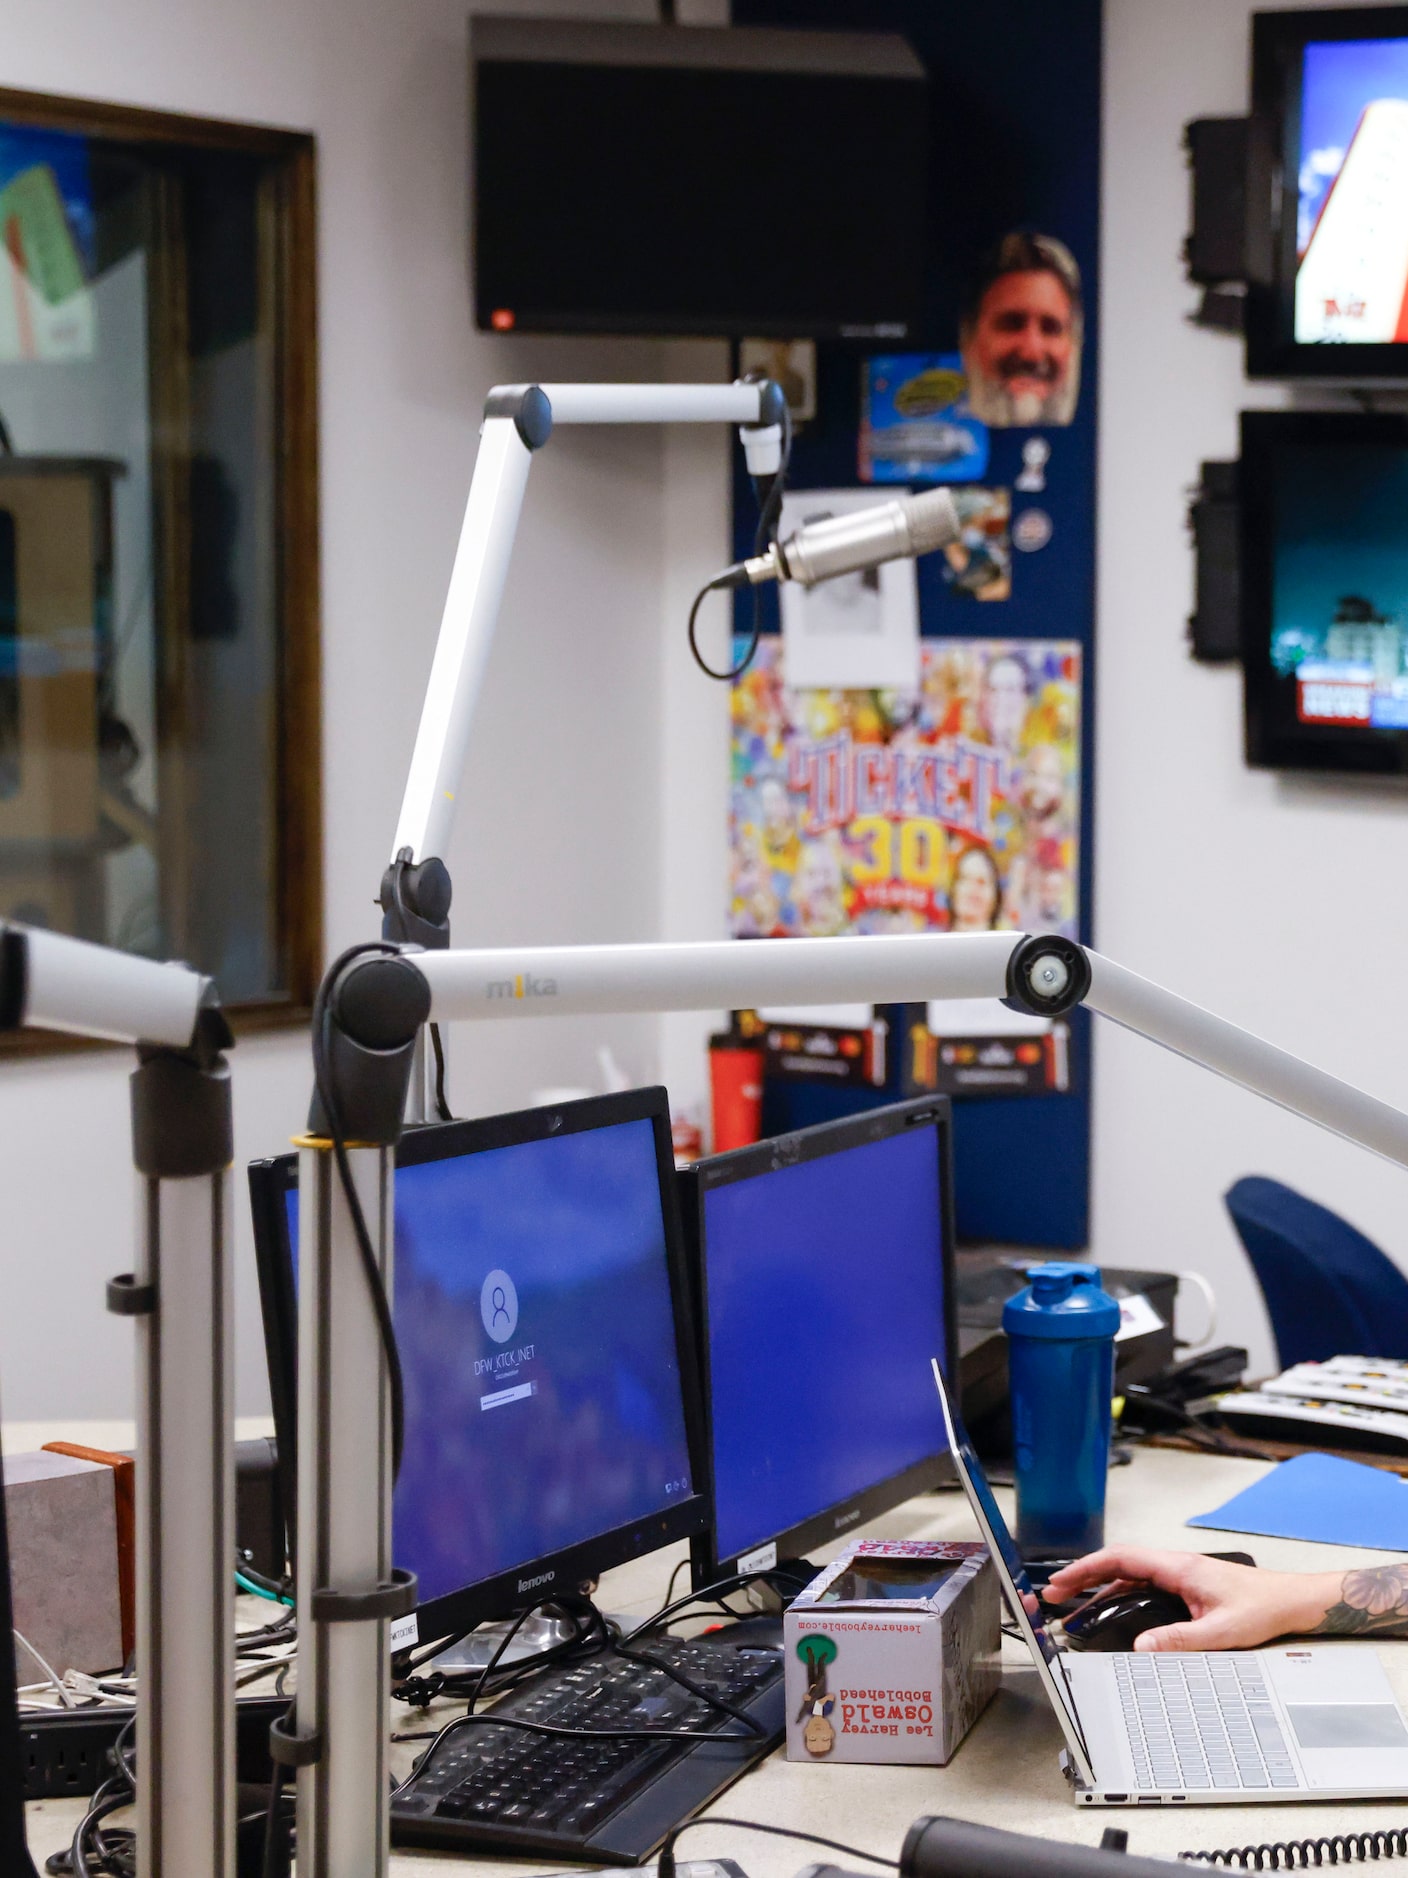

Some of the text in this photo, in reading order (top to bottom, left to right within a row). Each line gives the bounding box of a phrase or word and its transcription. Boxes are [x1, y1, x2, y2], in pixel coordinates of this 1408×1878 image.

[788, 735, 1004, 838] TICKET
[852, 817, 944, 885] 30
[485, 972, 558, 999] mika
[473, 1344, 535, 1376] DFW_KTCK_INET
[517, 1570, 556, 1594] lenovo
[798, 1621, 921, 1634] leeharveybobble.com
[840, 1689, 932, 1702] Bobblehead
[841, 1704, 933, 1723] Oswald
[841, 1719, 934, 1737] Lee Harvey
